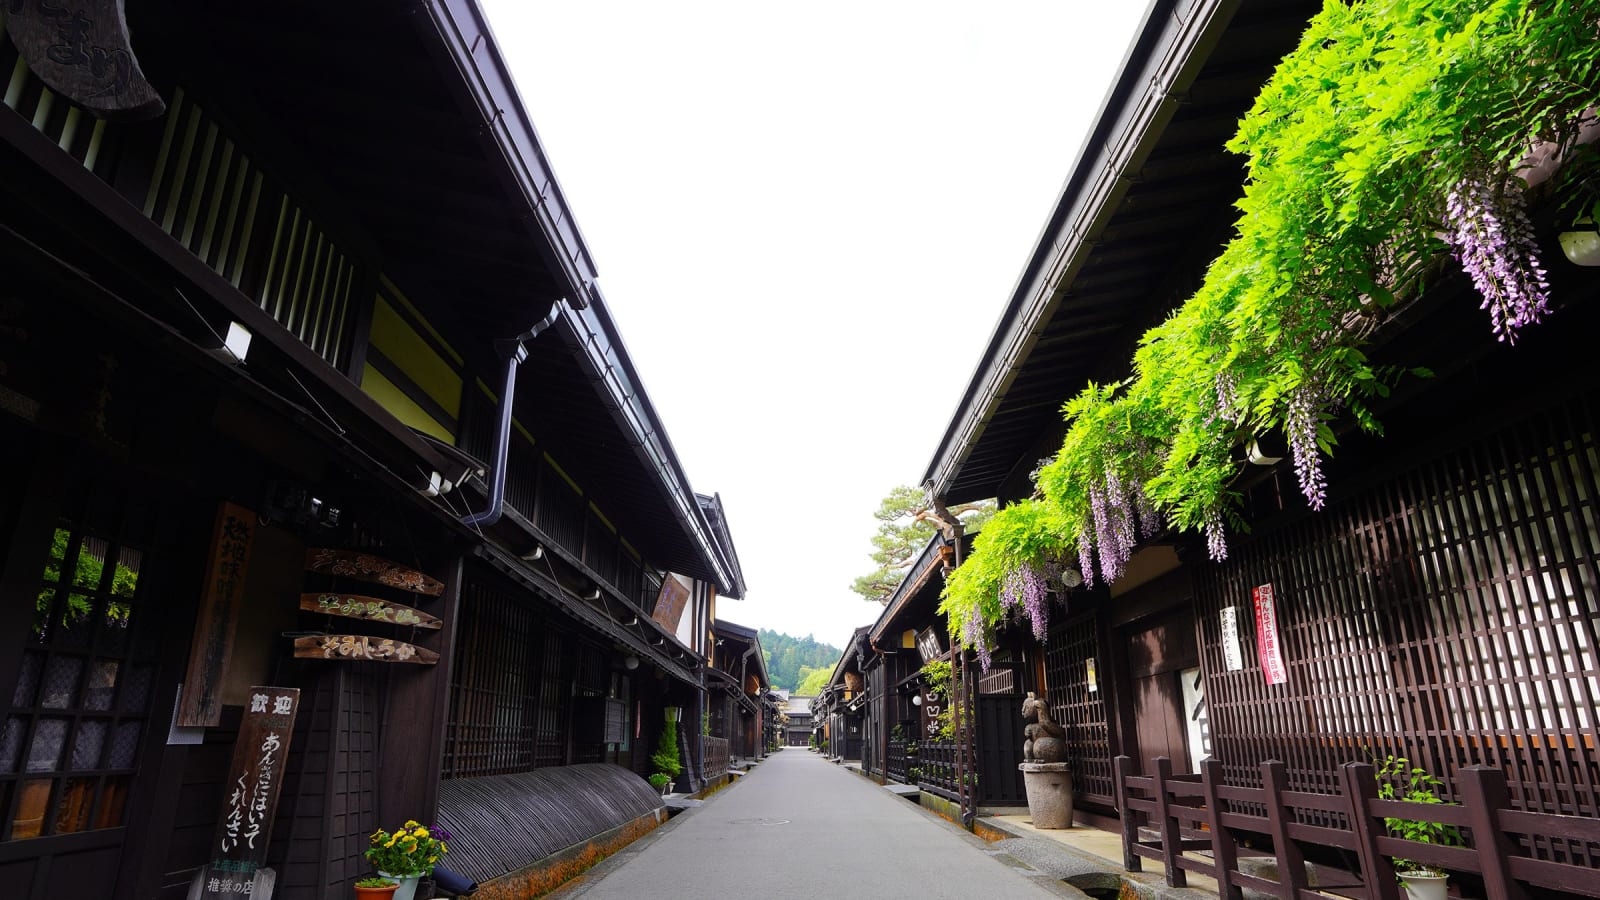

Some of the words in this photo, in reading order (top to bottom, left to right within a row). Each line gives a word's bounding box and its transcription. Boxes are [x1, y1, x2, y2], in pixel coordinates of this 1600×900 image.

[251, 693, 292, 715] 歓迎
[222, 770, 247, 853] くれんさい
[207, 877, 254, 895] 推奨の店
